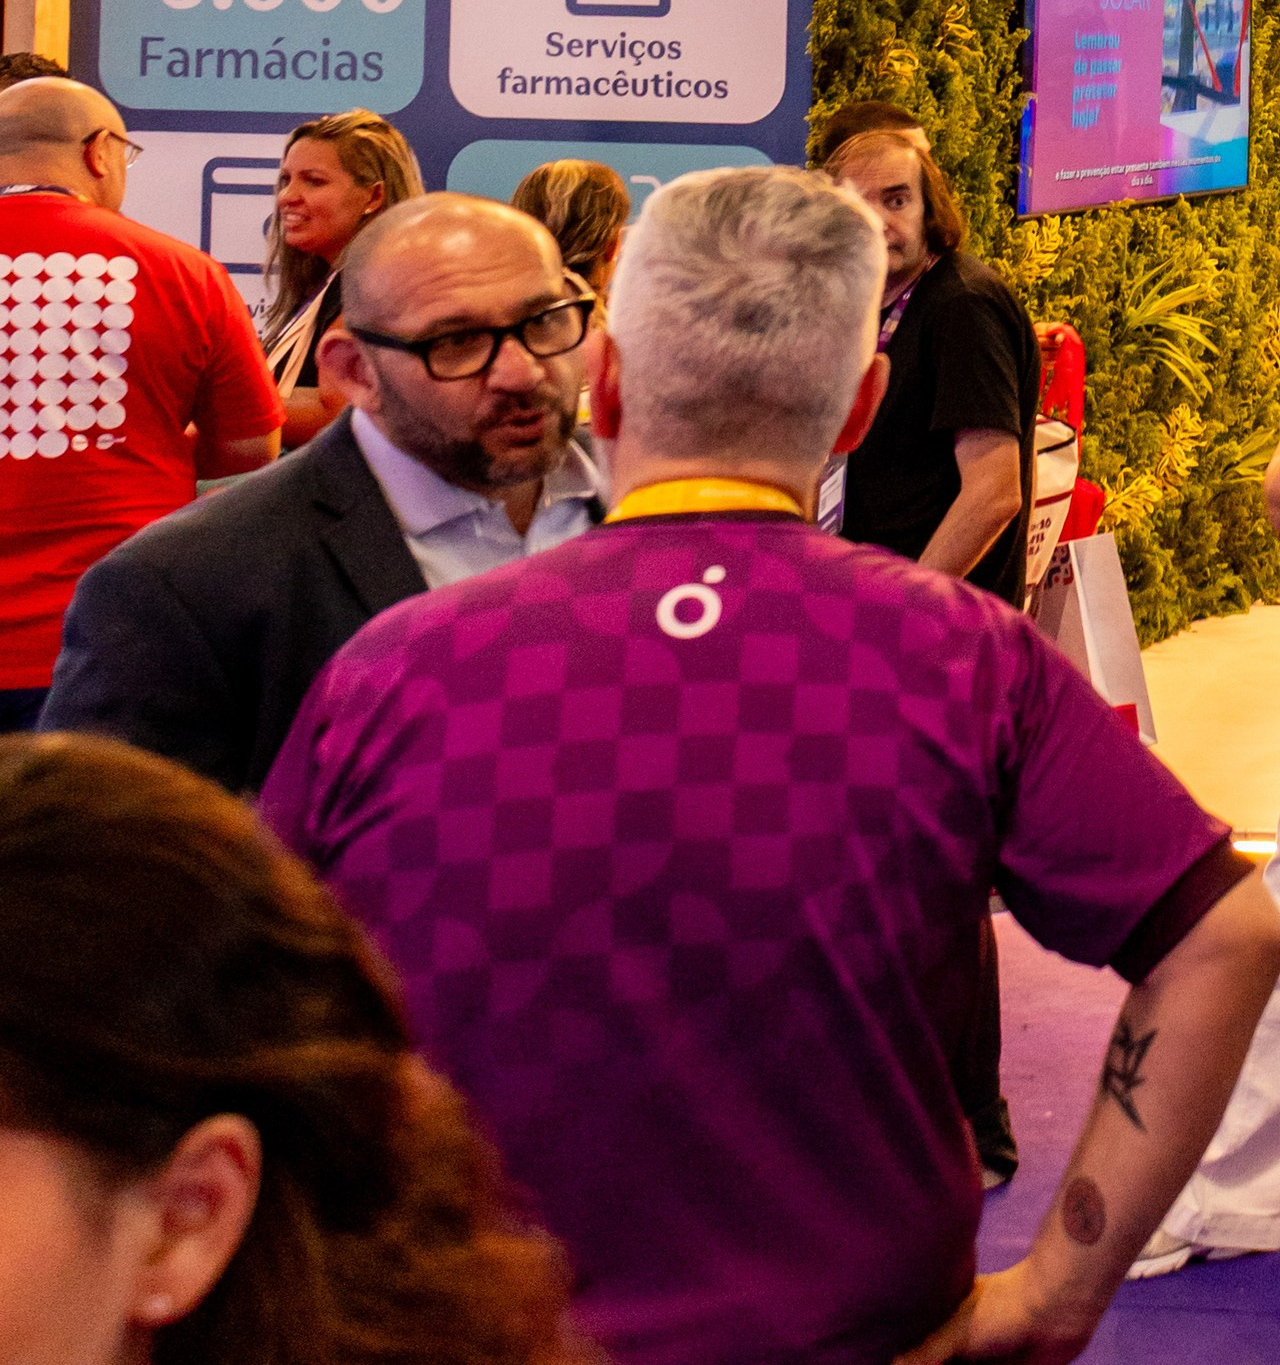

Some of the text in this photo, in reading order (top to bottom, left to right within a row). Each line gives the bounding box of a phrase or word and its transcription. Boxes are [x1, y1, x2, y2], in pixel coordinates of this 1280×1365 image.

[138, 36, 385, 83] Farmácias
[545, 31, 683, 67] Serviços
[497, 66, 730, 100] farmacêuticos
